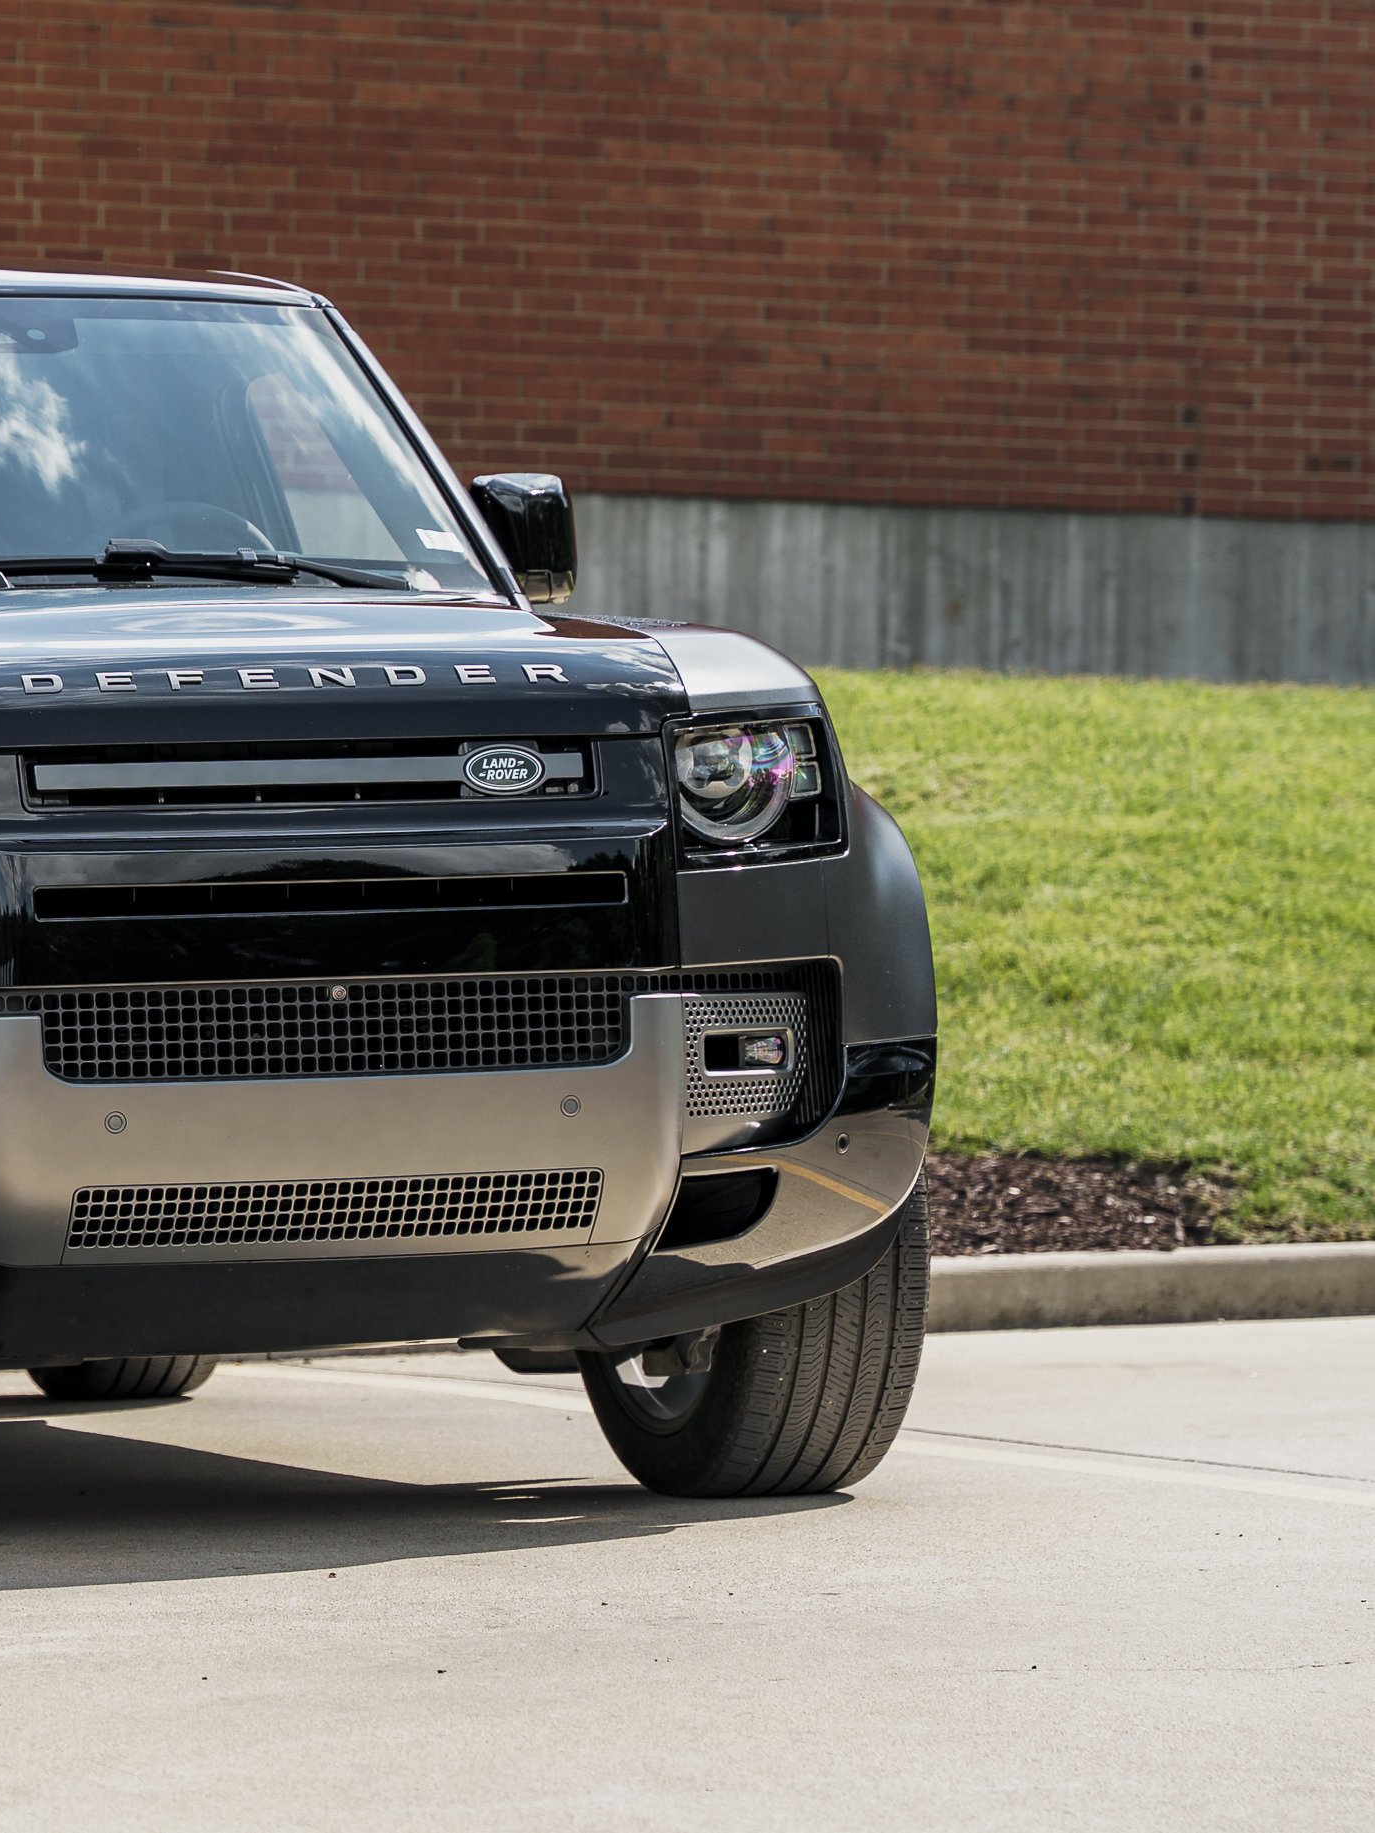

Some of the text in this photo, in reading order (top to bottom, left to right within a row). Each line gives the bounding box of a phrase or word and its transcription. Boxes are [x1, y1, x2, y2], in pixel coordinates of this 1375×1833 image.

[20, 663, 570, 694] DEFENDER
[482, 757, 517, 769] LAND
[486, 768, 528, 780] ROVER
